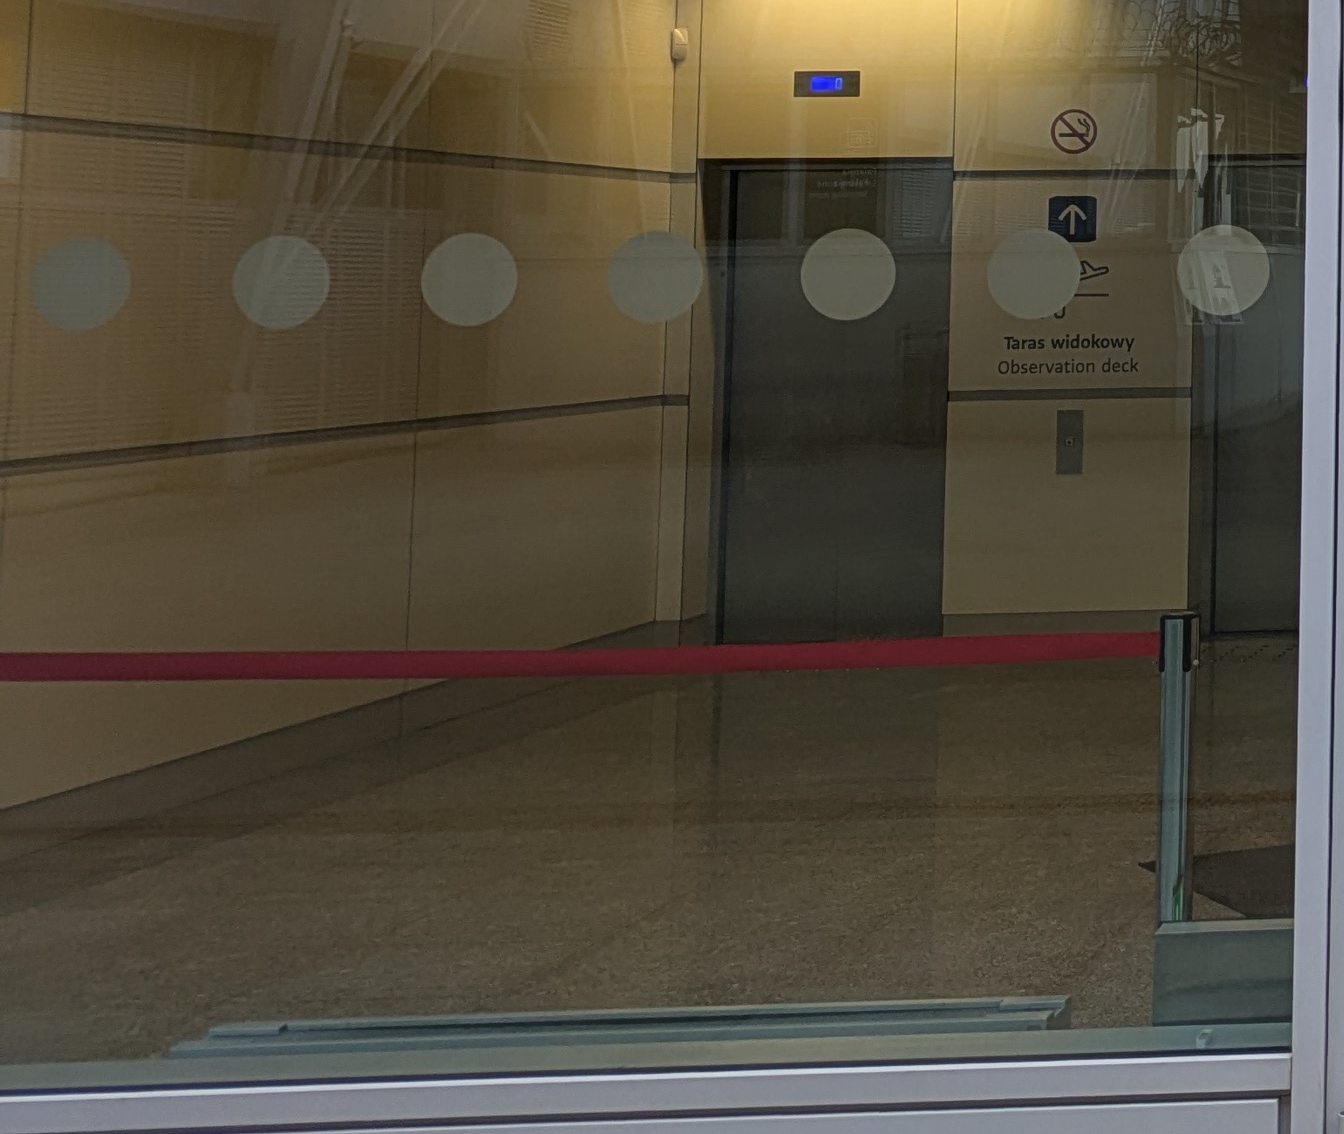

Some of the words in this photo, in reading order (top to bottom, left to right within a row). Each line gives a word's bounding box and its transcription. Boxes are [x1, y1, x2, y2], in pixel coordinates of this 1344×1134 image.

[1003, 336, 1045, 350] Taras
[1051, 333, 1136, 352] widokowy
[997, 358, 1096, 375] Observation
[1101, 357, 1140, 374] deck
